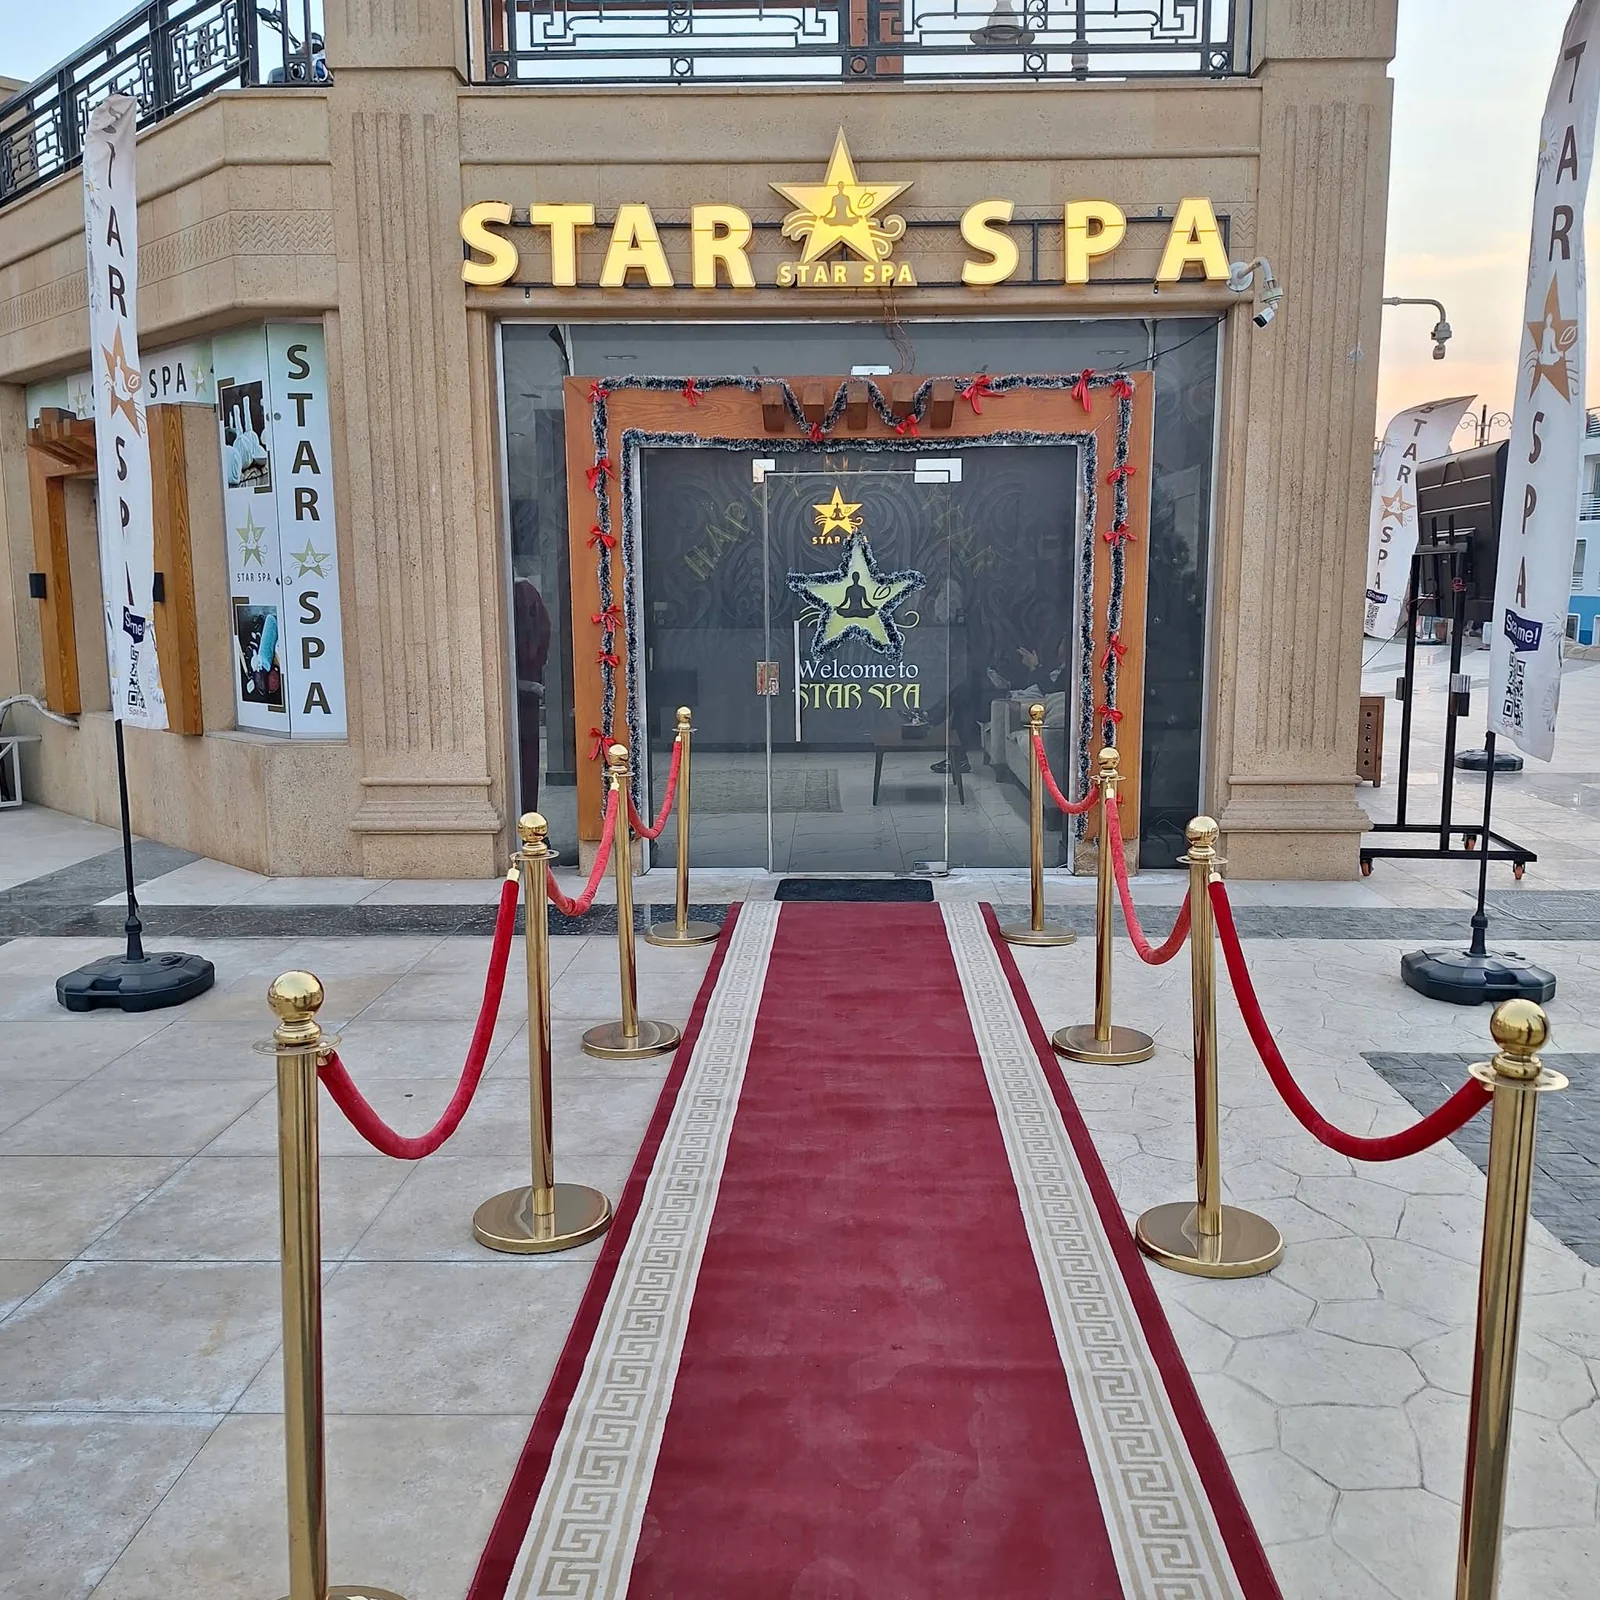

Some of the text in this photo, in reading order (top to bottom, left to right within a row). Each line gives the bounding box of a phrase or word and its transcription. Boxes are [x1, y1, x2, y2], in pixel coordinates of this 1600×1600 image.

[1549, 40, 1588, 261] TAR
[459, 197, 1232, 288] STAR SPA
[780, 264, 913, 283] STAR SPA
[149, 362, 187, 399] SPA
[286, 343, 321, 521] STAR
[1516, 411, 1546, 609] SPA
[812, 536, 841, 545] STAR
[1374, 526, 1394, 590] SPA
[236, 572, 271, 582] STAR SPA
[299, 590, 332, 715] SPA
[800, 659, 896, 679] Welcome
[792, 683, 920, 709] STAR SPA
